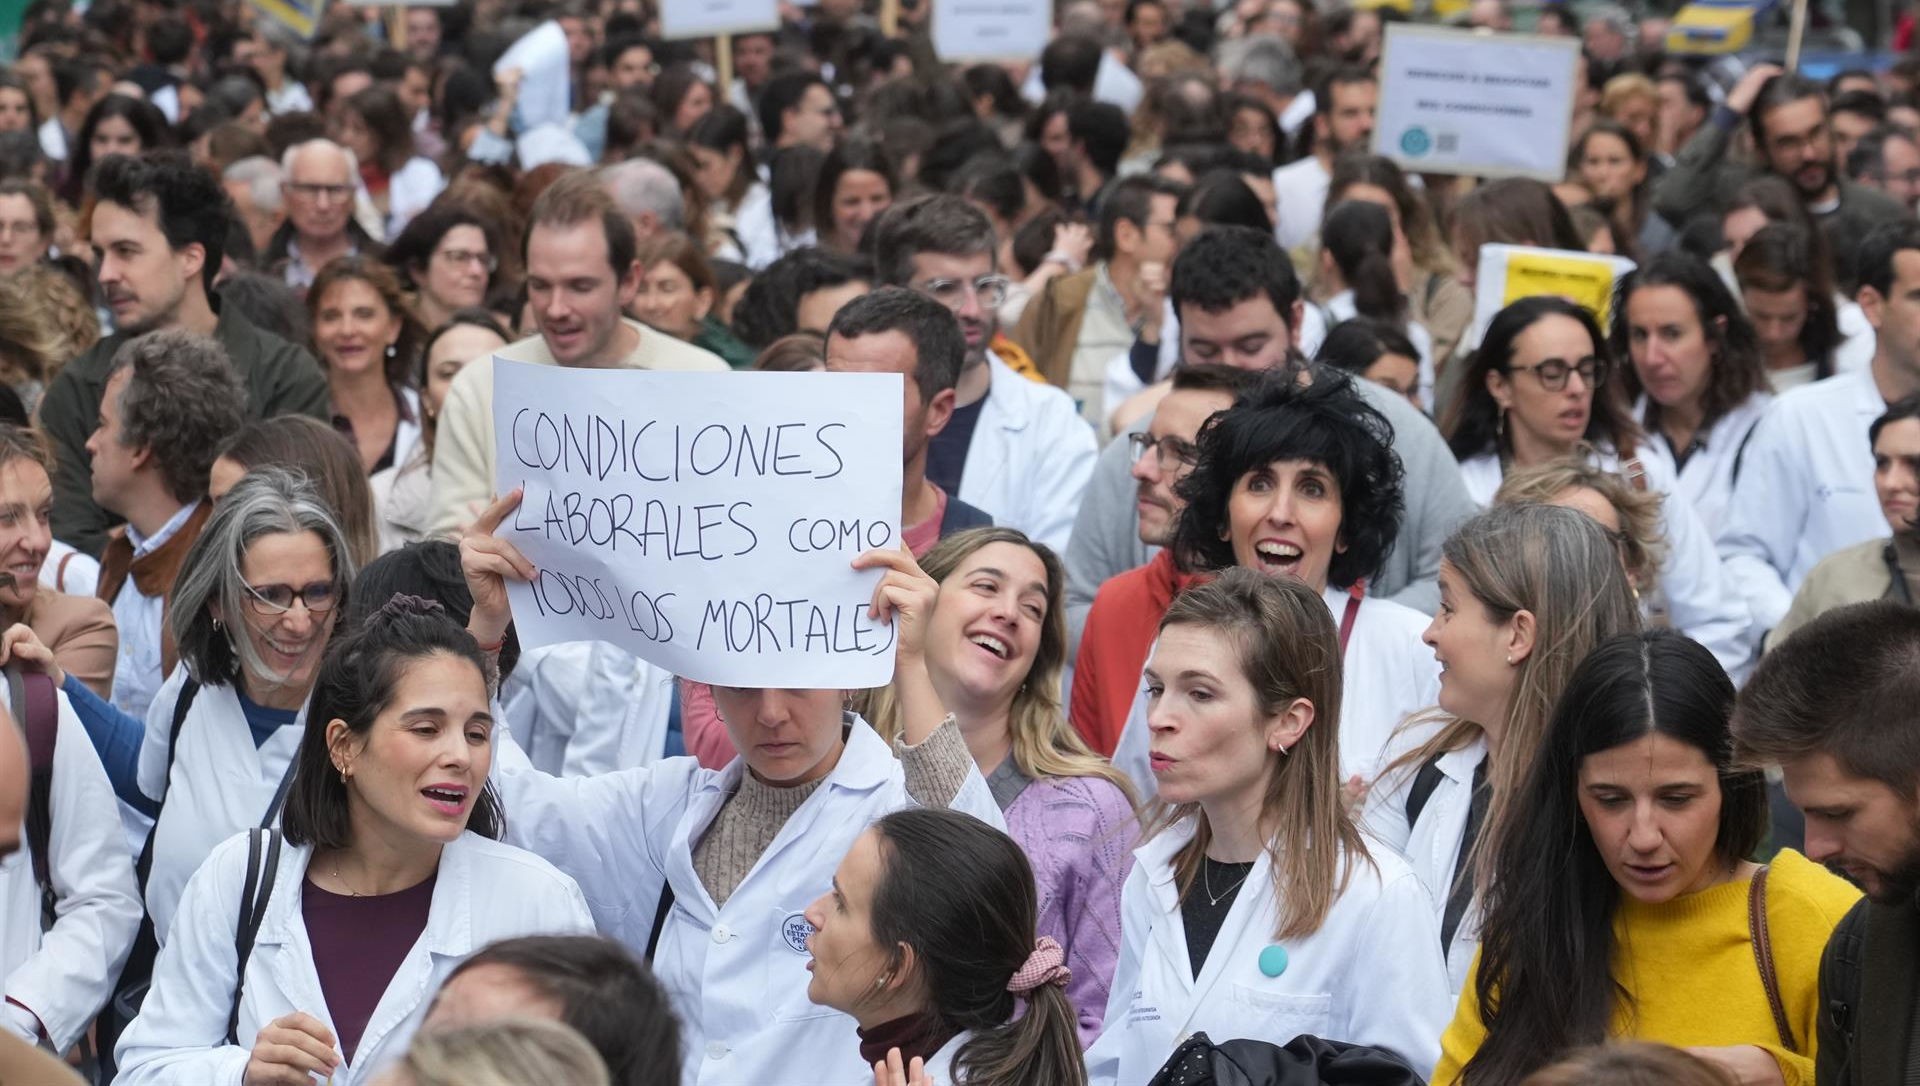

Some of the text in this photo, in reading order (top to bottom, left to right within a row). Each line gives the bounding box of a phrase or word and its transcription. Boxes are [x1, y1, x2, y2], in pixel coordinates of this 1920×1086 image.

[513, 408, 846, 482] CONDICIONES
[515, 480, 891, 560] LABORALES COMO
[615, 585, 676, 643] LOS
[790, 923, 805, 931] POR
